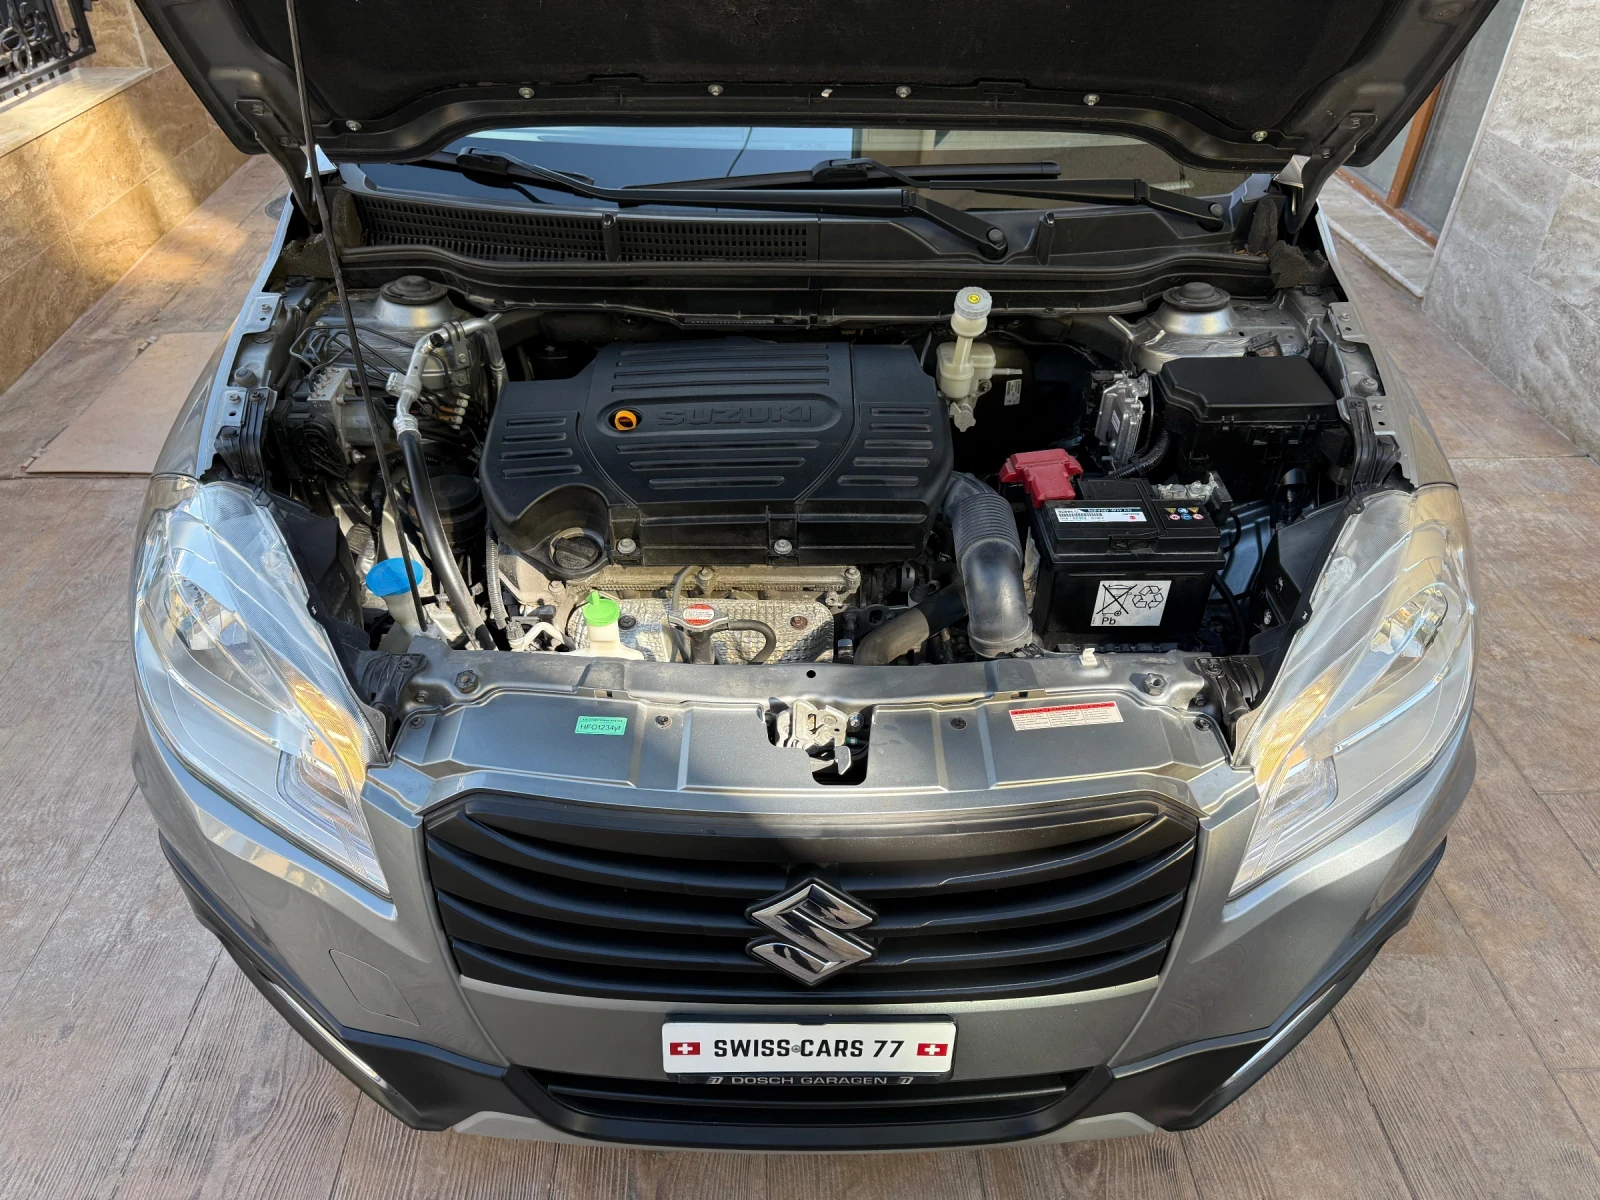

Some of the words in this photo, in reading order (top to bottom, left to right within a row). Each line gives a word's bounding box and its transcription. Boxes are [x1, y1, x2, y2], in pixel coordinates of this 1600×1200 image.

[657, 406, 812, 426] SUZUKI
[1101, 616, 1116, 625] Pb
[714, 1039, 790, 1057] SWISS
[800, 1039, 864, 1057] CARS
[873, 1040, 905, 1057] 77
[731, 1076, 794, 1085] DOSCH
[800, 1076, 887, 1085] GARAGEN
